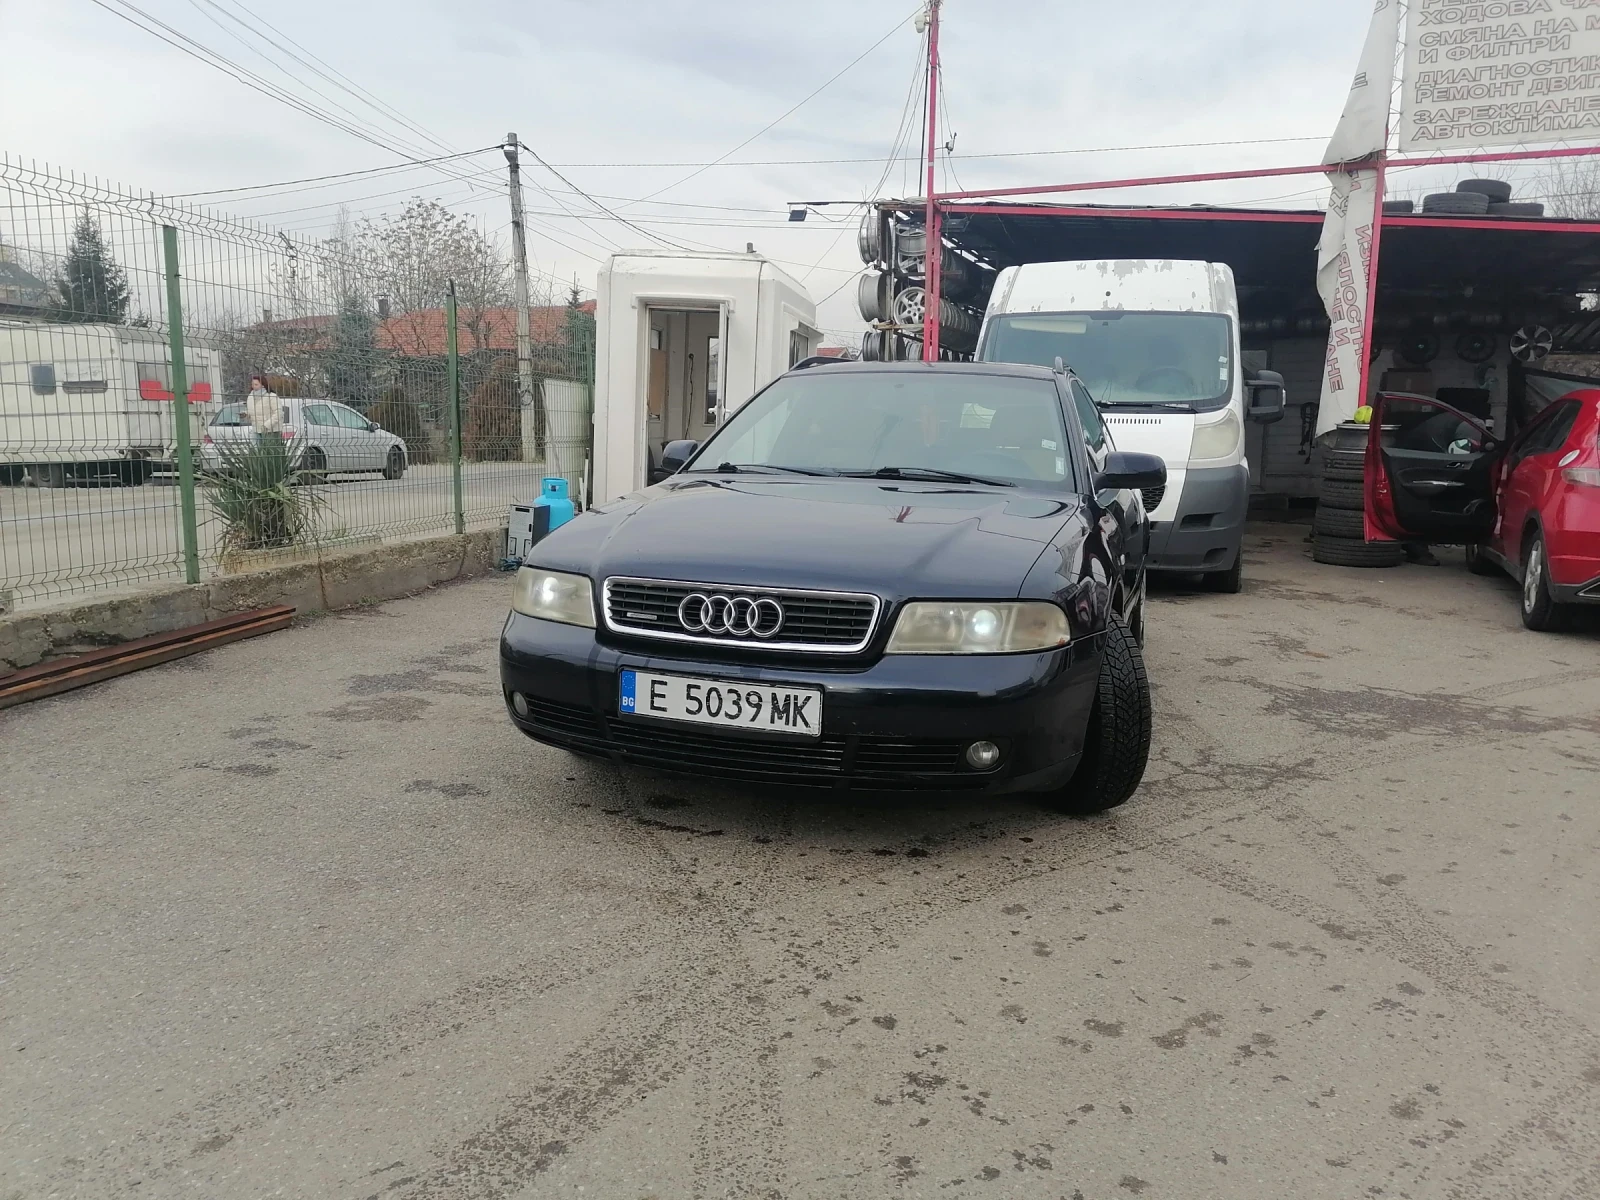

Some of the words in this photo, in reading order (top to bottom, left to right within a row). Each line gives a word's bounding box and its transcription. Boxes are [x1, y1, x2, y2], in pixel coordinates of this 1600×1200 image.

[1417, 0, 1552, 26] ХОДОВА
[1419, 22, 1527, 47] СМЯНА
[1534, 17, 1579, 36] НА
[1418, 48, 1438, 64] И
[1446, 34, 1571, 61] ФИЛТРИ
[1416, 80, 1524, 104] РЕМОНТ
[1527, 73, 1600, 97] ДВИГ
[1413, 95, 1600, 125] ЗАРЕЖДАНЕ
[1411, 111, 1600, 141] АВТОКЛИМА
[622, 696, 634, 707] BG
[650, 679, 668, 712] E
[685, 683, 763, 722] 5039
[770, 692, 812, 728] MK
